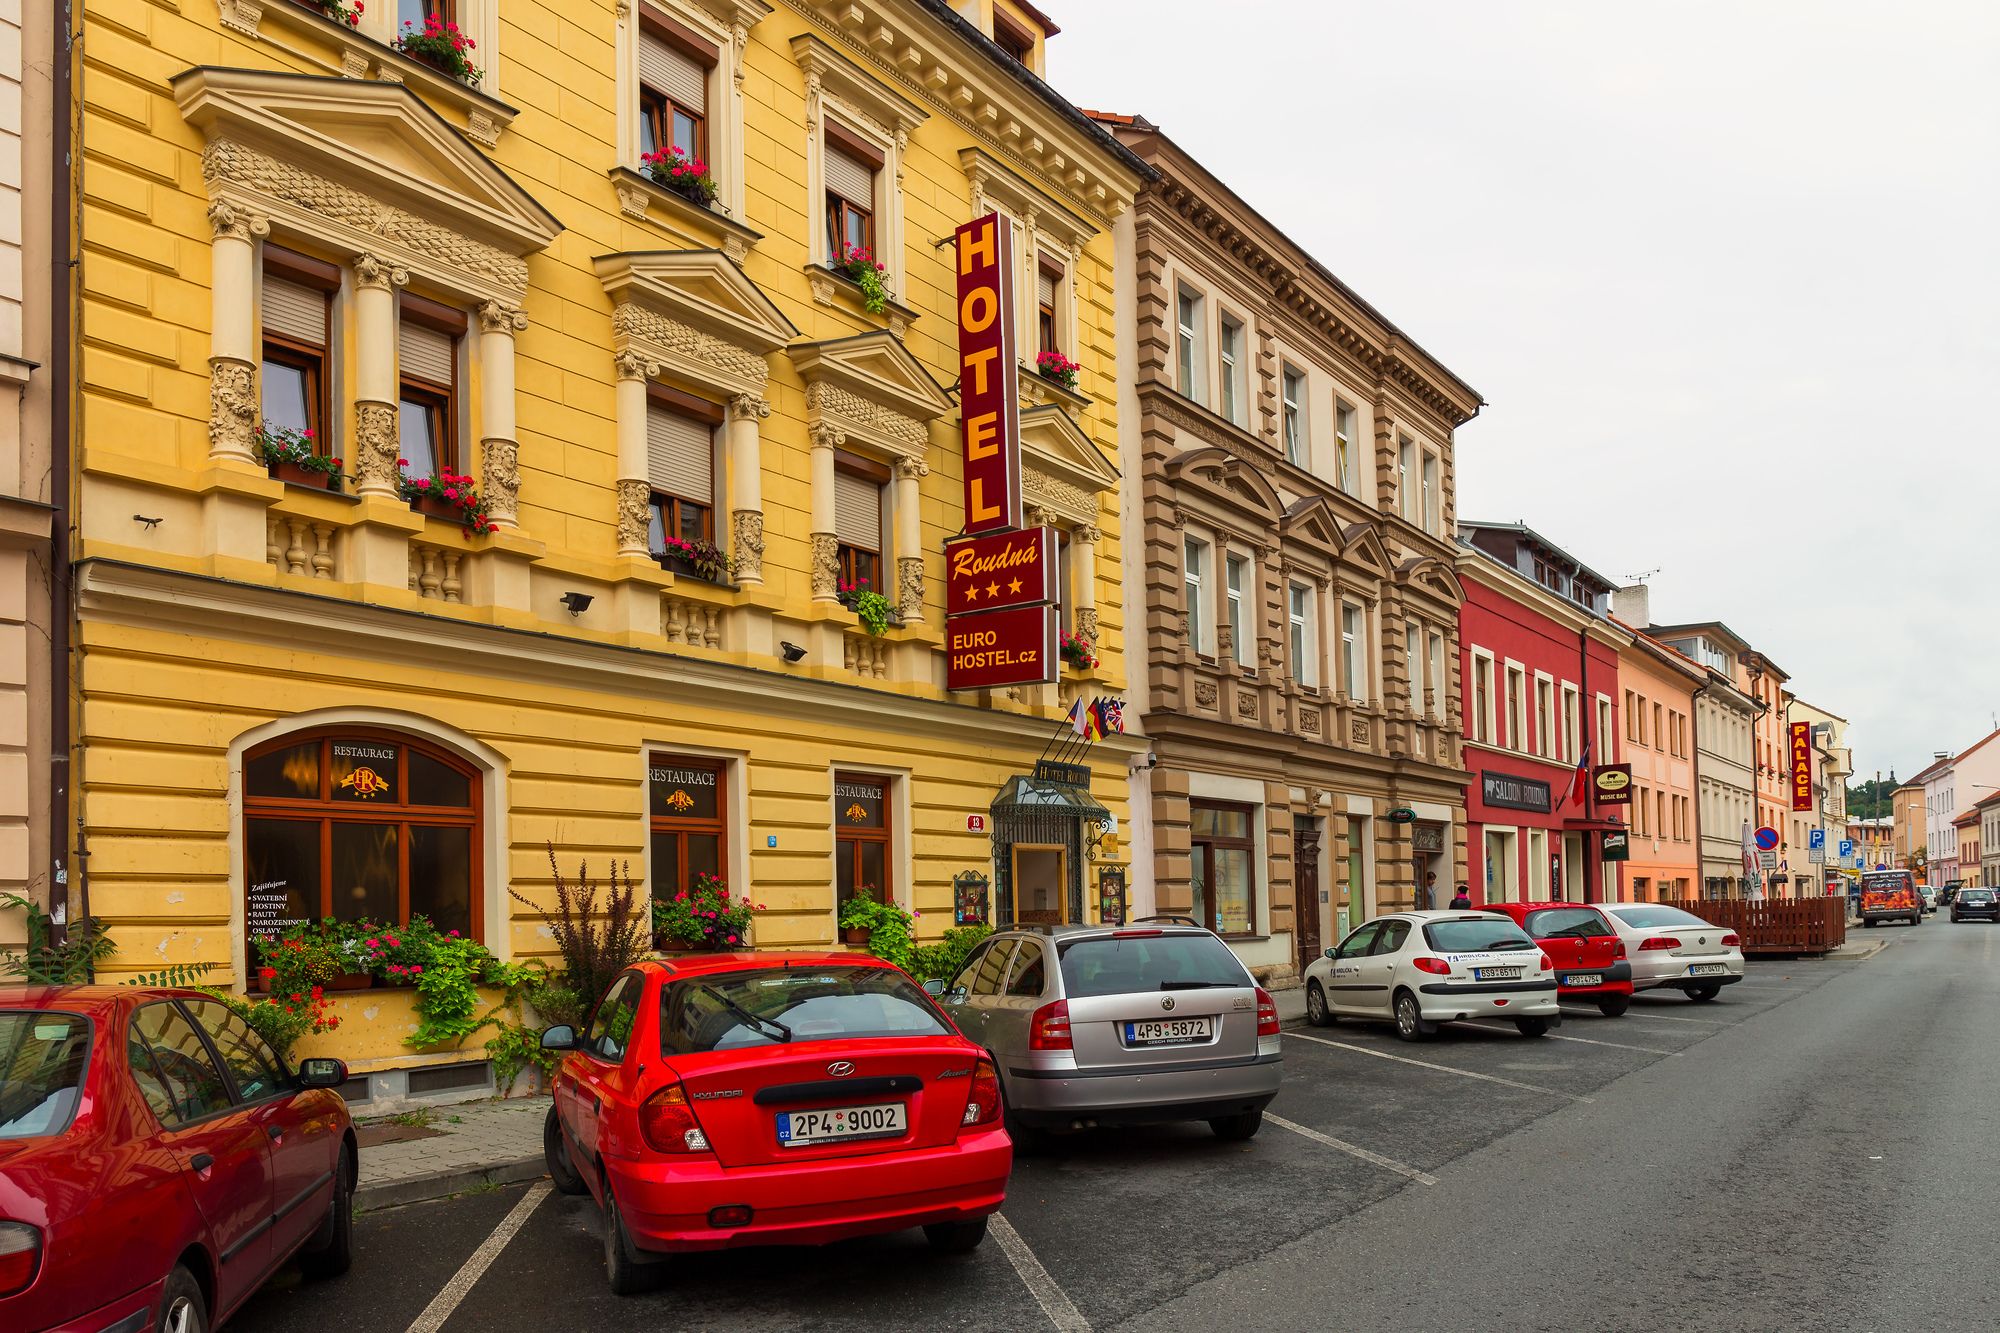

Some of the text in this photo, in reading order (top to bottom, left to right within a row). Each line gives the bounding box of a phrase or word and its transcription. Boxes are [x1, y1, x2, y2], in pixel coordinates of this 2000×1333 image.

[960, 221, 1000, 524] HOTEL
[953, 535, 1038, 582] Roudná
[954, 631, 997, 650] EURO
[334, 745, 394, 760] RESTAURACE
[1794, 725, 1809, 797] PALACE
[1495, 780, 1521, 802] SALOON
[973, 816, 979, 827] 13
[251, 880, 287, 891] Zajišťujeme
[252, 893, 288, 902] SVATEBNÍ
[1499, 968, 1517, 977] 6511
[1138, 1021, 1205, 1039] 4P9 5872
[692, 1089, 743, 1100] HYUNDAI
[795, 1107, 897, 1136] 2P4 9002
